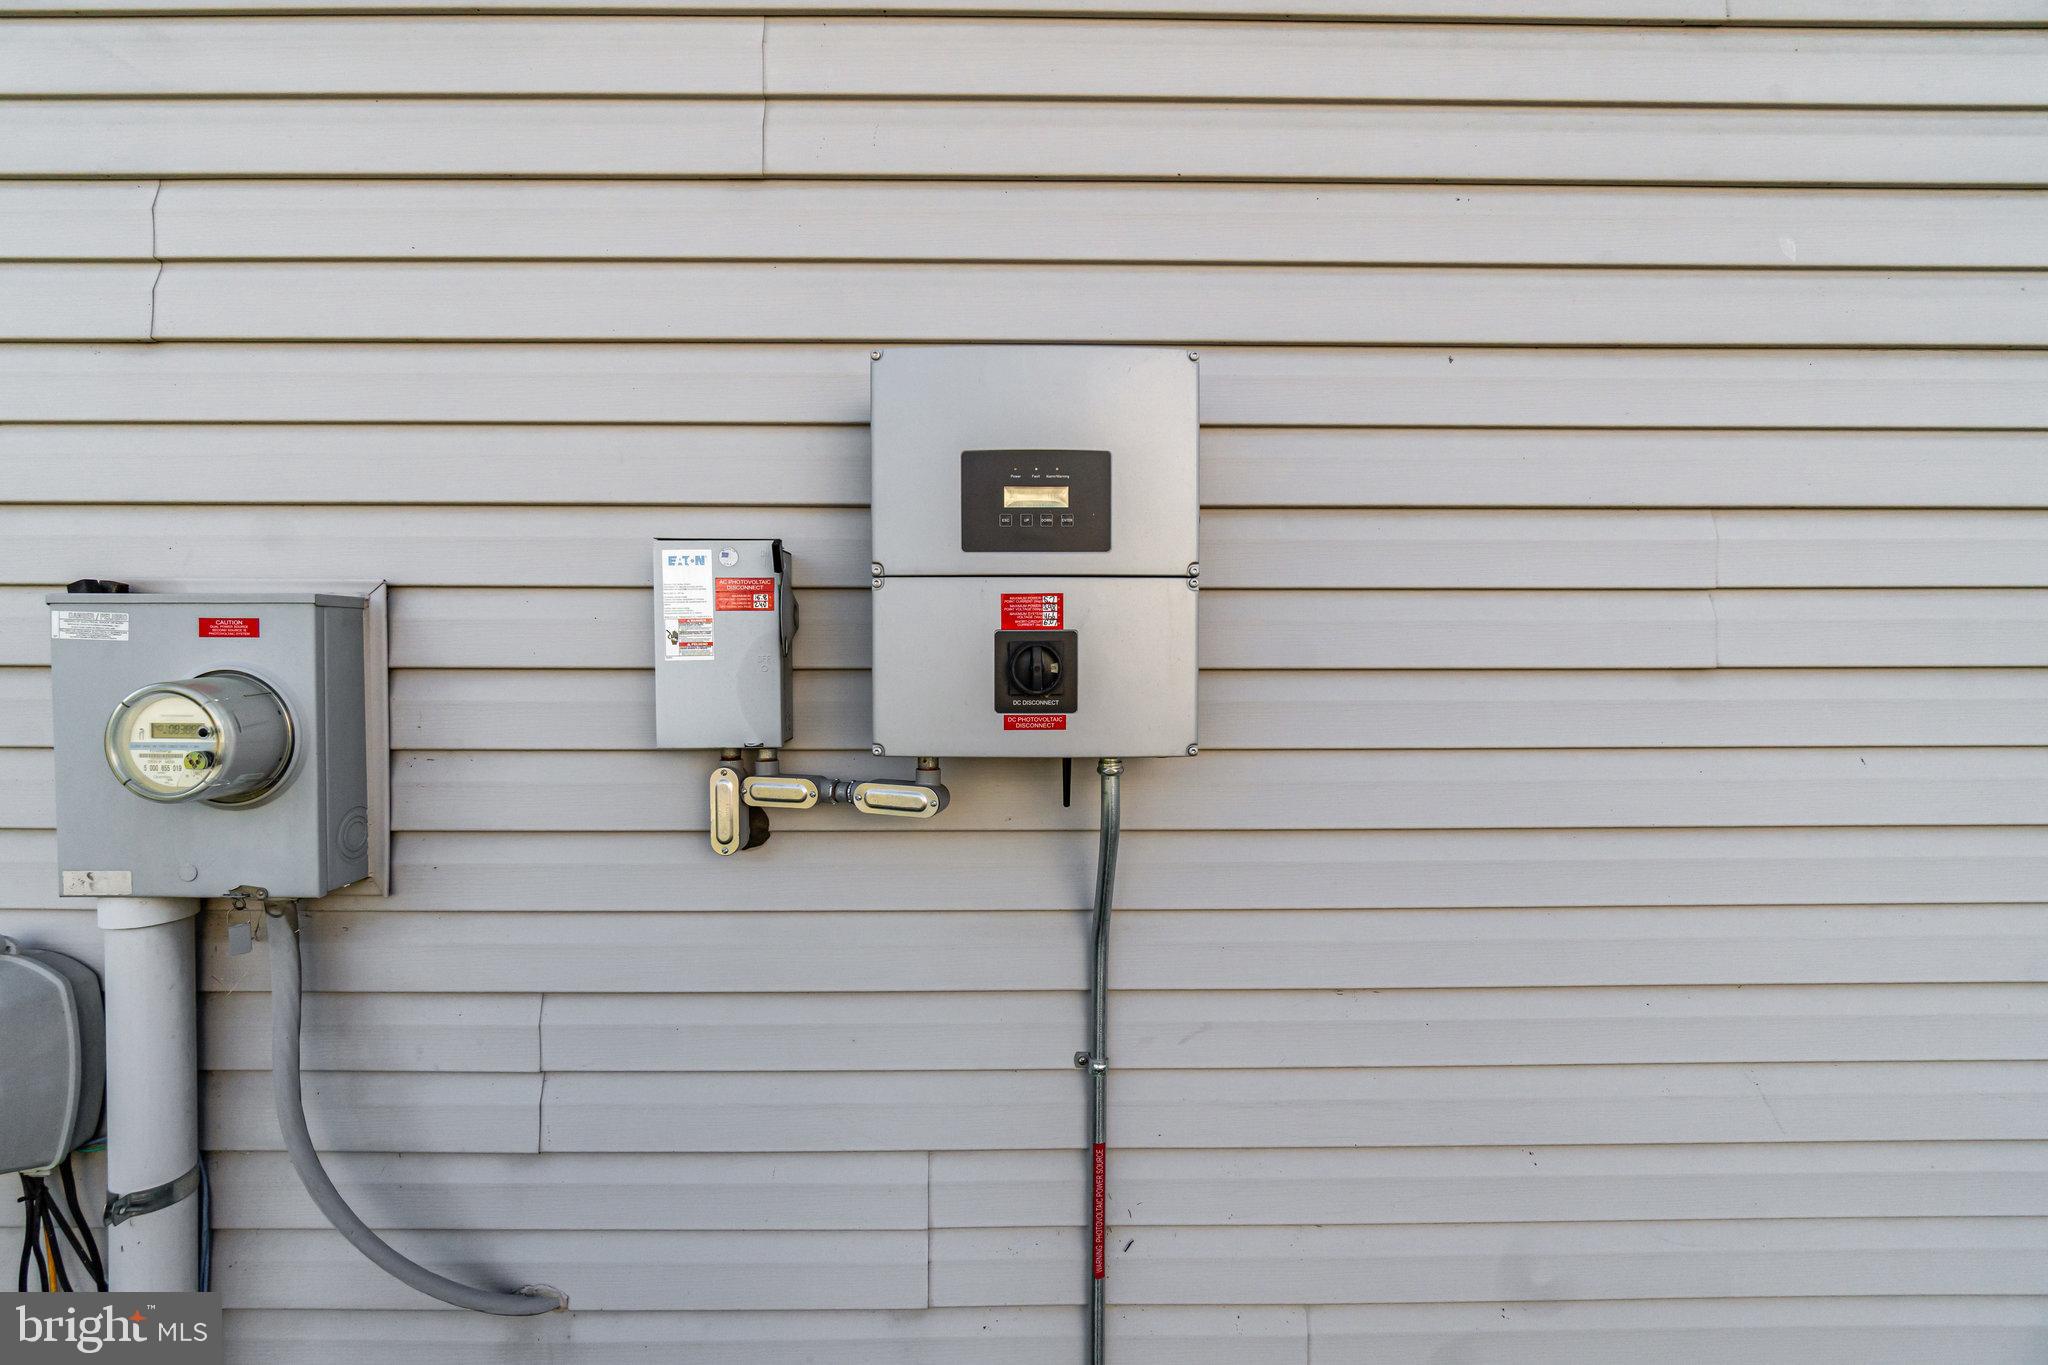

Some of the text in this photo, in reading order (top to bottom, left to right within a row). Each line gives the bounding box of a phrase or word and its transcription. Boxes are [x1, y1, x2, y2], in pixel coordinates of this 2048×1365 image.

[1095, 1149, 1104, 1174] SOURCE
[1095, 1175, 1104, 1197] POWER
[1095, 1198, 1104, 1243] PHOTOVOLTAIC
